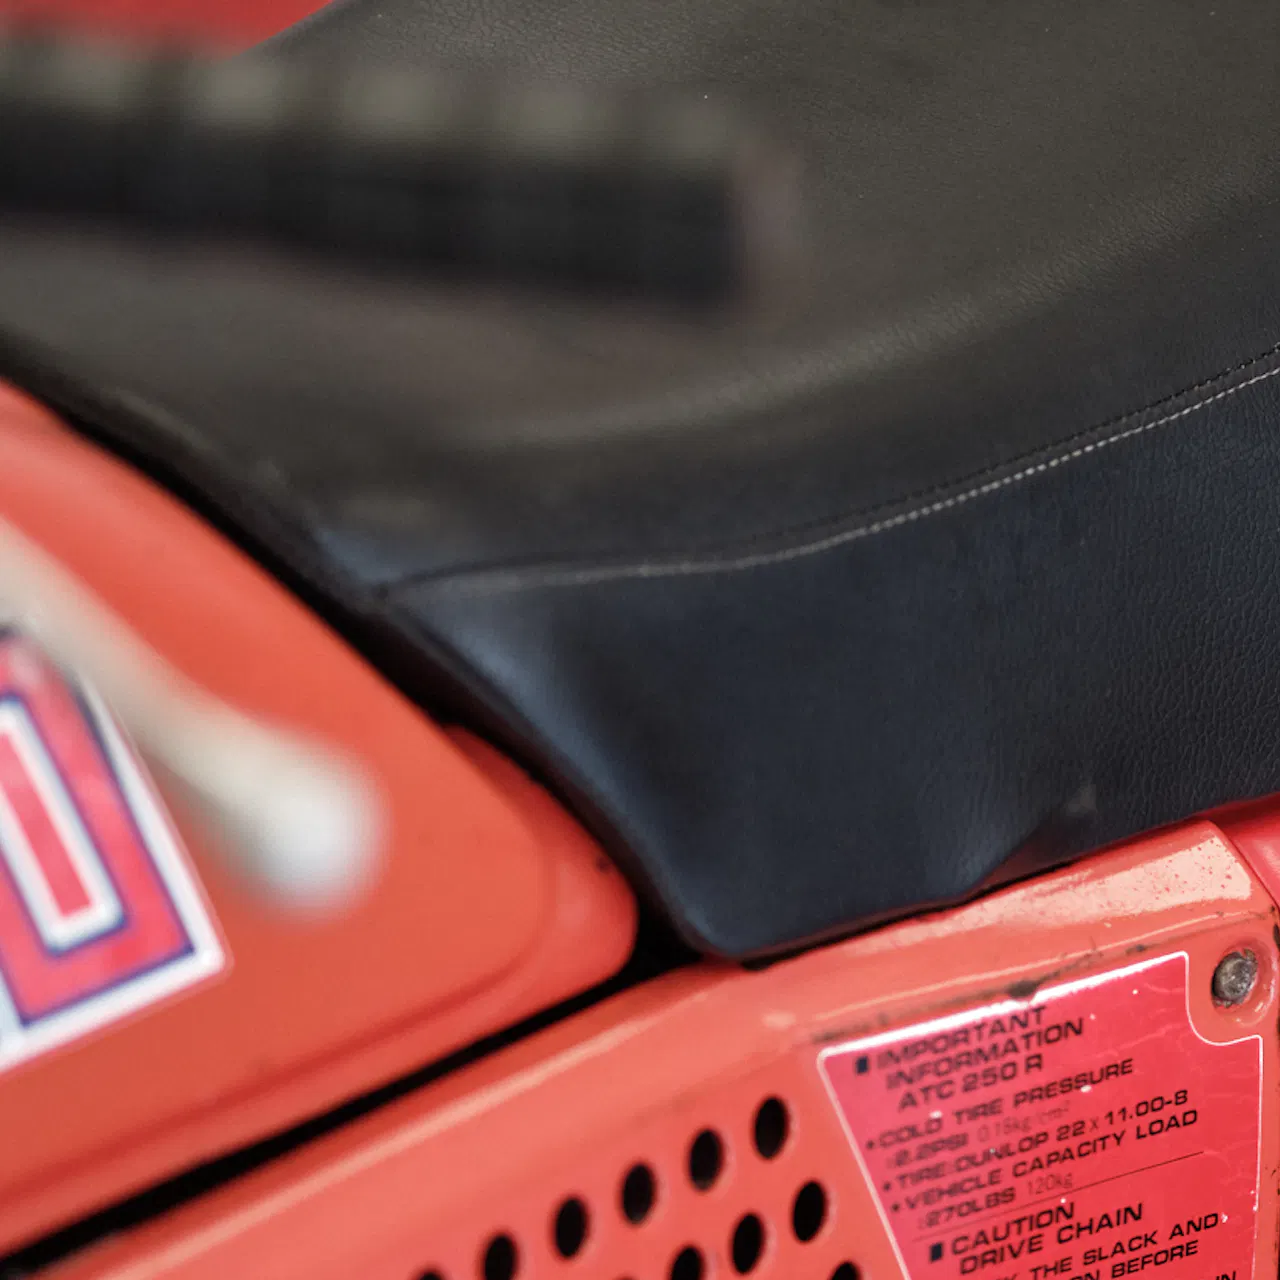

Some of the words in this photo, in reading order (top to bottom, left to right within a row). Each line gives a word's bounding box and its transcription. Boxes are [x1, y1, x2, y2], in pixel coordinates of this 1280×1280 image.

[877, 1006, 1046, 1068] IMPORTANT
[886, 1017, 1084, 1089] INFORMATION
[879, 1117, 943, 1148] COLD
[954, 1098, 1003, 1125] TIRE
[1013, 1058, 1133, 1107] PRESSURE
[899, 1080, 956, 1111] ATC
[962, 1062, 1017, 1092] 250
[1025, 1054, 1043, 1073] R
[905, 1169, 1002, 1209] VEHICLE
[1012, 1131, 1126, 1178] CAPACITY
[1136, 1110, 1198, 1140] LOAD
[952, 1202, 1075, 1255] CAUTION
[960, 1234, 1044, 1275] DRIVE
[1057, 1203, 1143, 1244] CHAIN
[1030, 1256, 1073, 1280] THE
[1083, 1230, 1158, 1266] SLACK
[1169, 1213, 1219, 1240] AND
[1111, 1240, 1199, 1279] BEFORE
